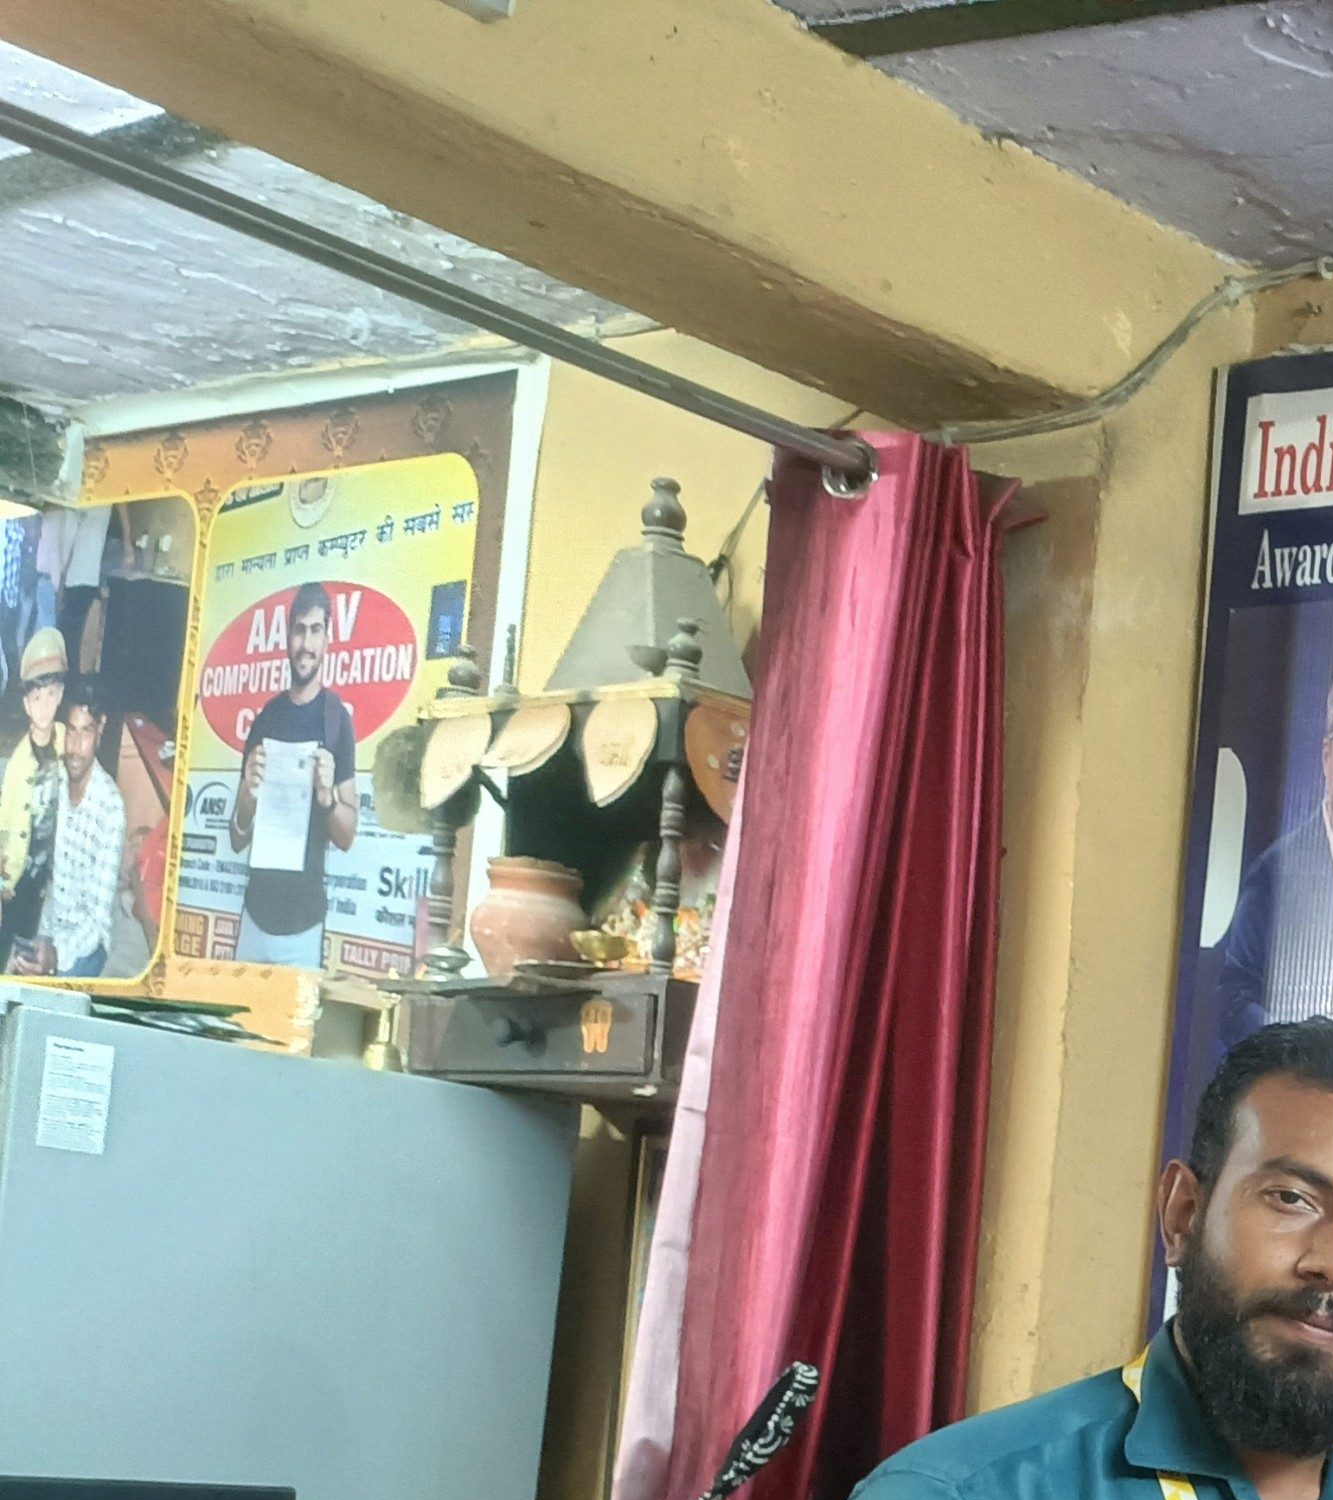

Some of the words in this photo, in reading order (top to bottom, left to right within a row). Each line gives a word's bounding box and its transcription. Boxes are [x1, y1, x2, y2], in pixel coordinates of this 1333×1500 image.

[247, 592, 362, 654] AAV
[322, 644, 413, 688] UCATION
[377, 866, 429, 899] Skill
